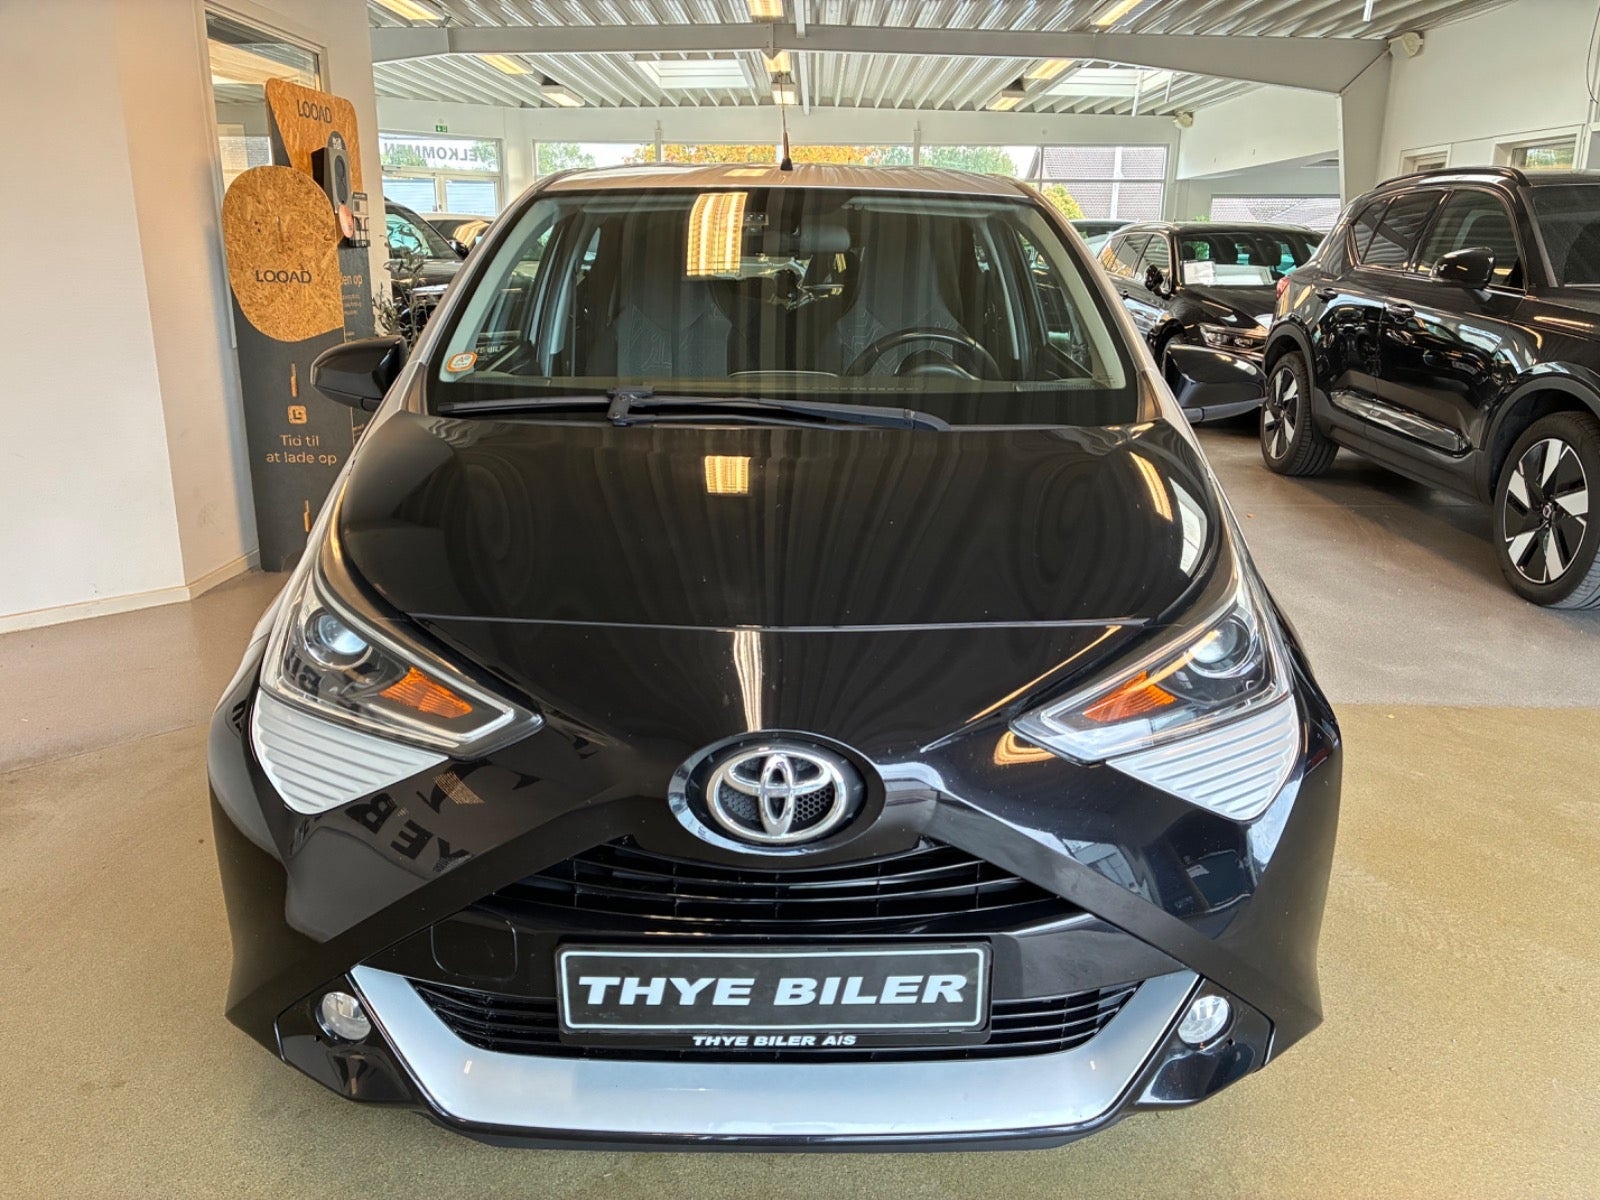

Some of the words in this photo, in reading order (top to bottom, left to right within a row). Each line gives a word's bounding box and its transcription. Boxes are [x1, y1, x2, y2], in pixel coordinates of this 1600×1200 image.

[296, 99, 332, 124] LOOAD
[255, 269, 312, 284] LOOAD
[280, 434, 302, 447] Tid
[305, 434, 319, 447] til
[266, 452, 281, 463] at
[283, 451, 315, 464] lade
[318, 453, 337, 466] op
[578, 976, 756, 1006] THYE
[773, 974, 968, 1006] BILER
[692, 1035, 750, 1047] THYE
[754, 1035, 817, 1047] BILER
[821, 1034, 857, 1046] A/S
